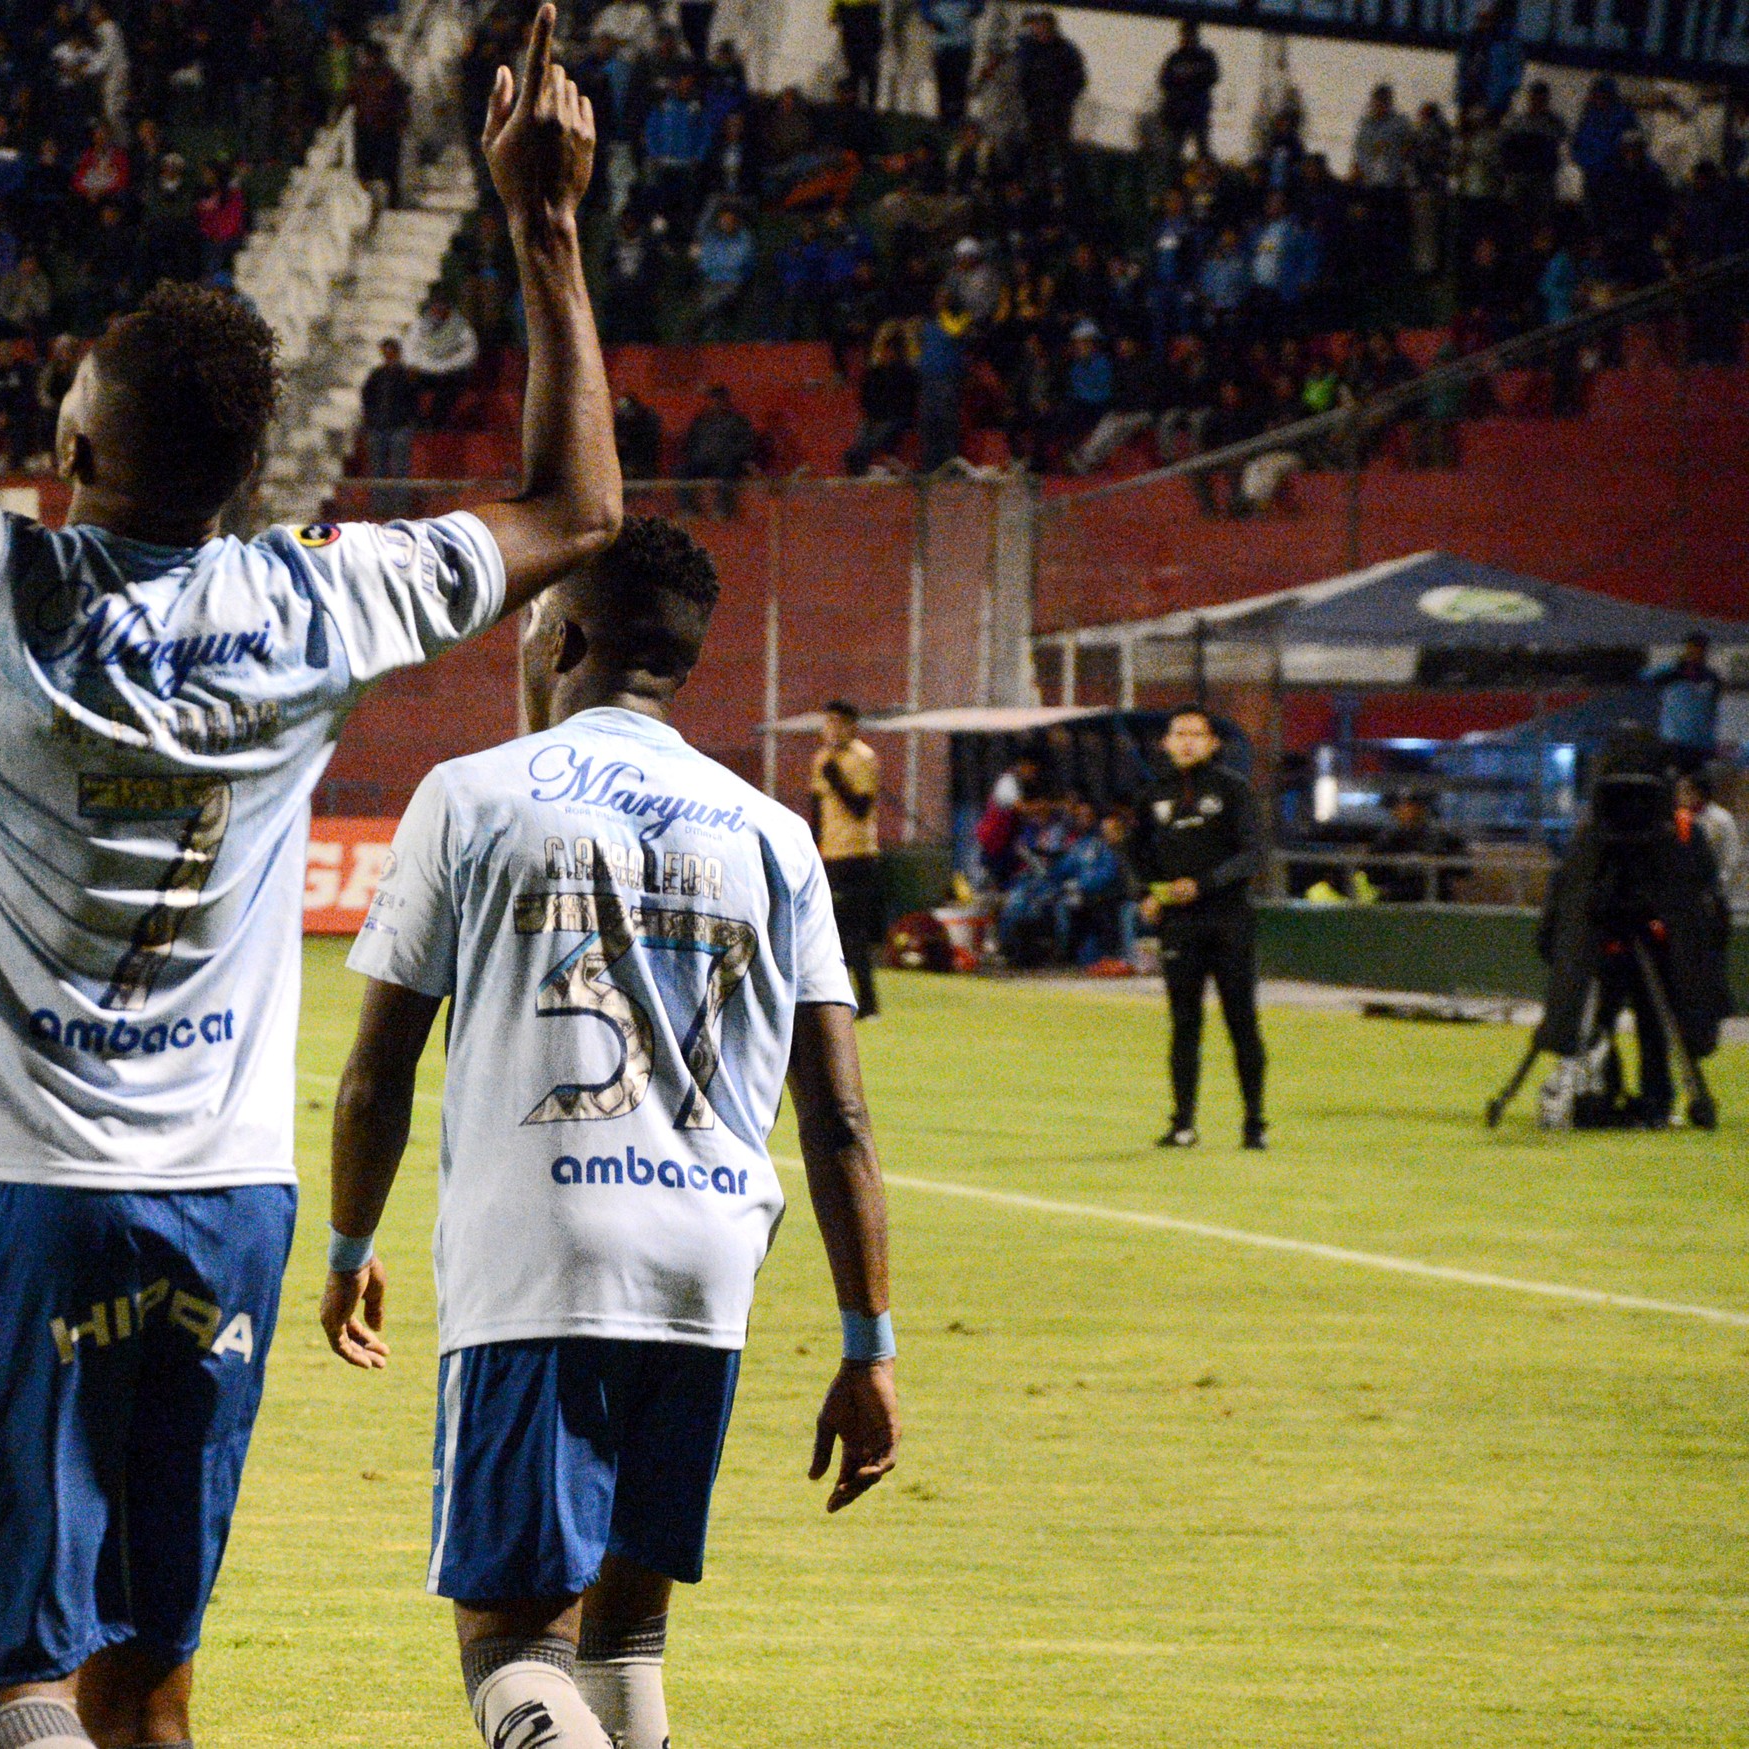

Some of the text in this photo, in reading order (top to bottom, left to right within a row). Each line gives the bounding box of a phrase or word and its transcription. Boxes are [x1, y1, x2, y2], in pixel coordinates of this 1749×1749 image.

[529, 744, 746, 842] Maryuri
[78, 772, 233, 1011] 7
[29, 1008, 234, 1053] ambacar
[513, 891, 759, 1129] 37
[551, 1146, 748, 1195] ambacar
